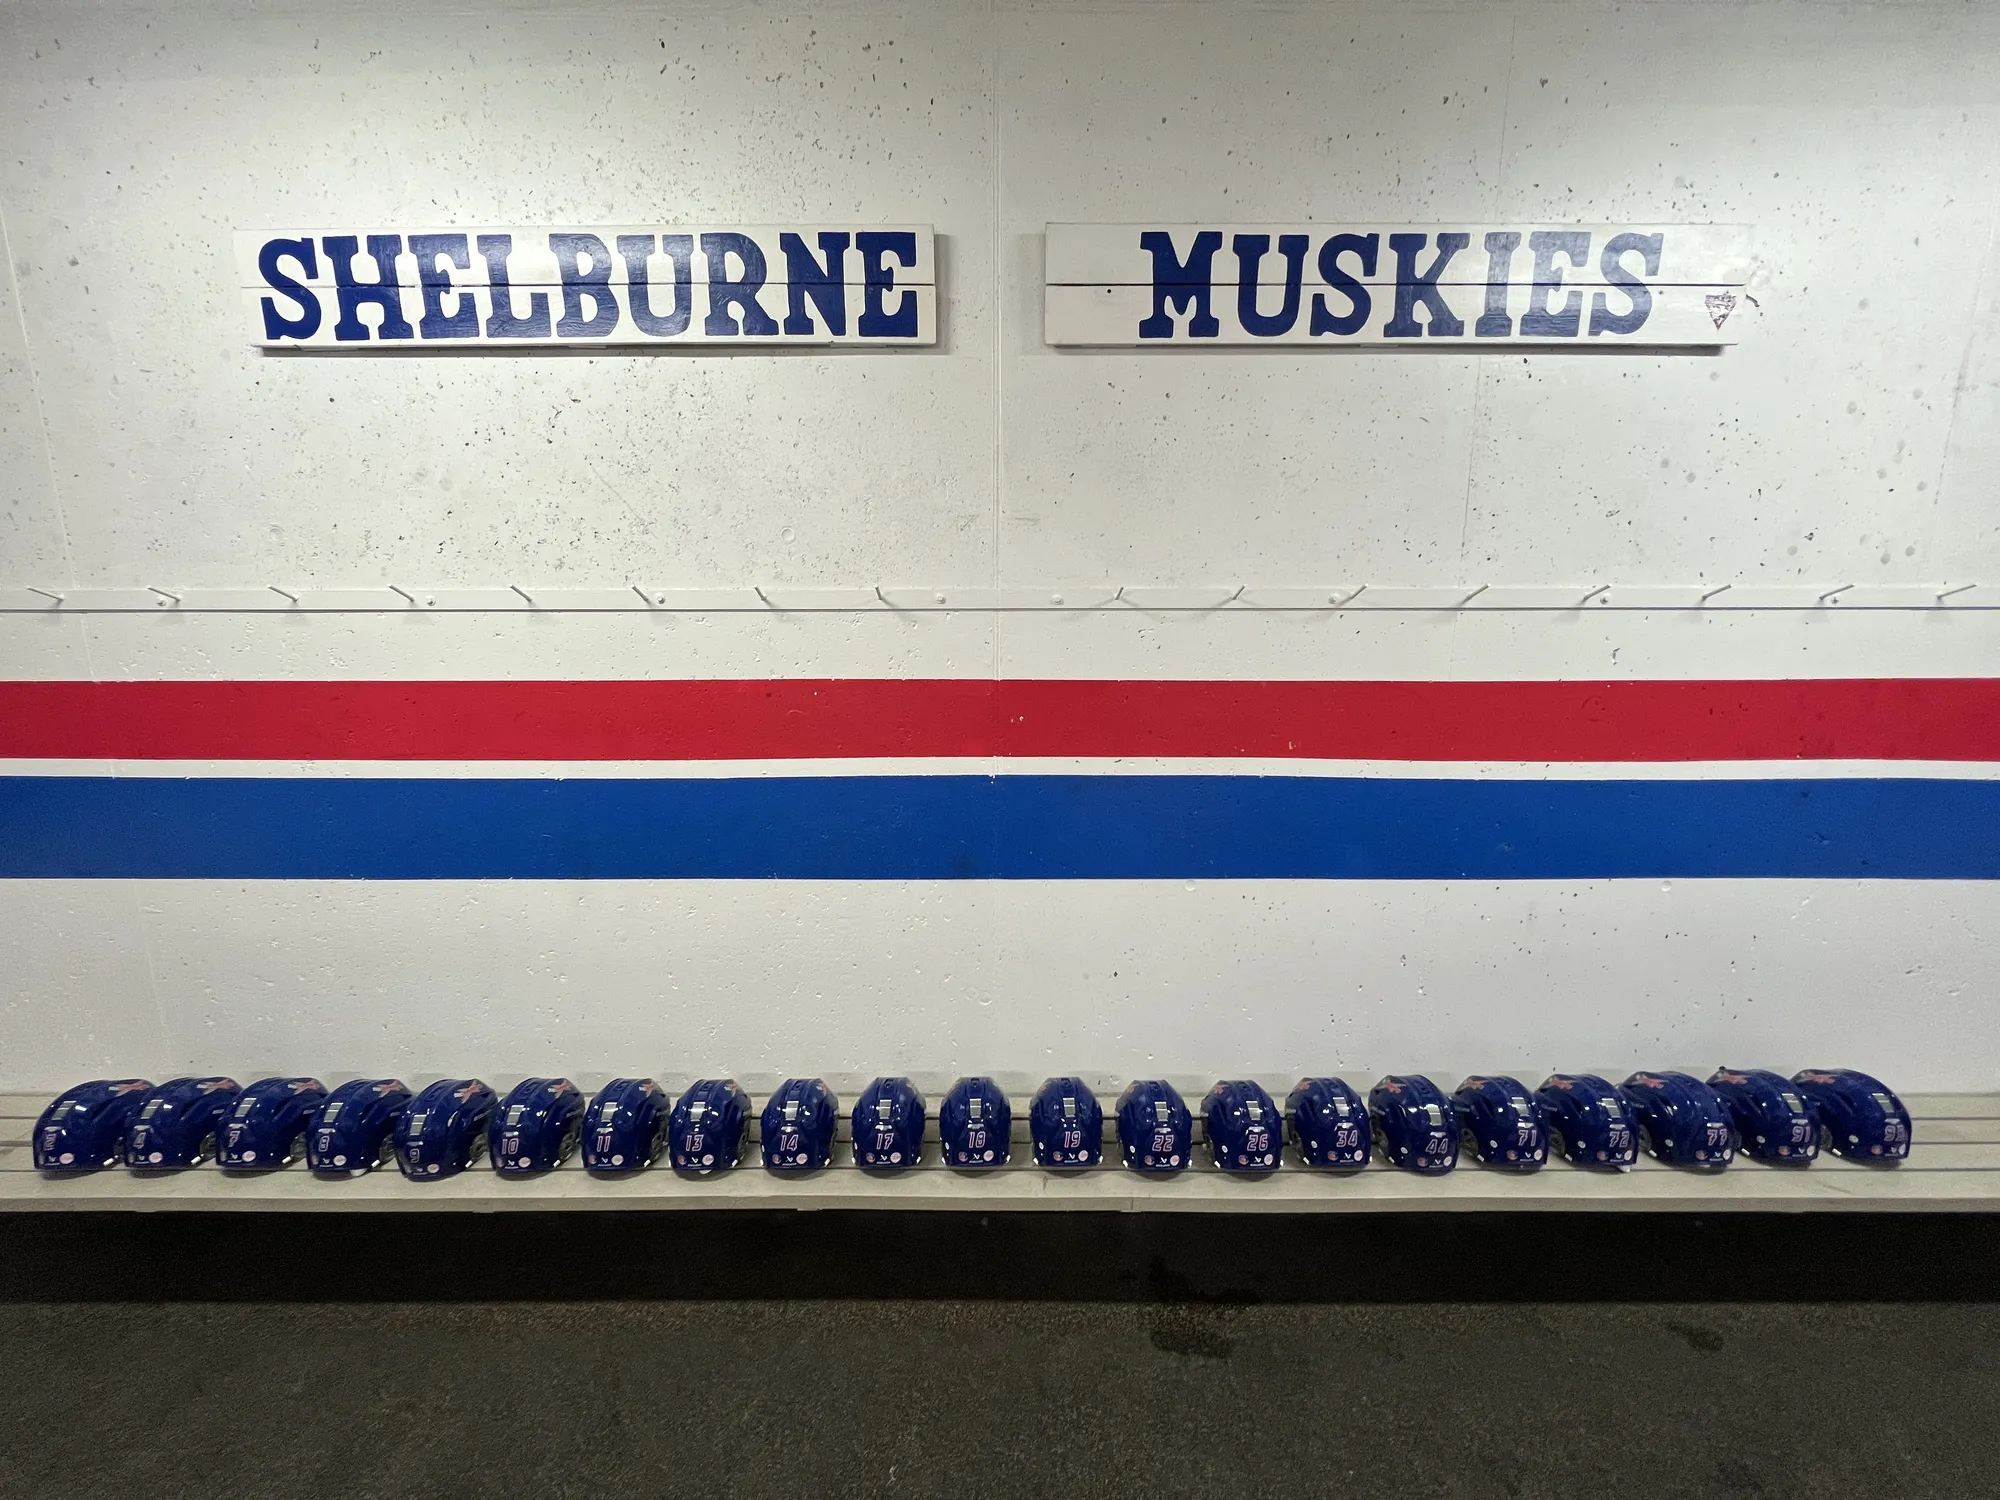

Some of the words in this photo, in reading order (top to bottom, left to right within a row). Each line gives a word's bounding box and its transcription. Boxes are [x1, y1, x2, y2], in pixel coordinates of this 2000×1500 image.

[258, 231, 918, 340] SHELBURNE
[1139, 231, 1665, 338] MUSKIES
[133, 1132, 147, 1149] 4
[685, 1134, 704, 1151] 13
[780, 1134, 799, 1151] 14
[876, 1132, 895, 1150] 17
[968, 1130, 986, 1148] 18
[1063, 1130, 1081, 1148] 19
[1151, 1134, 1174, 1151] 22
[1246, 1133, 1269, 1151] 26
[1336, 1129, 1358, 1148] 34
[1518, 1129, 1537, 1146] 71
[1609, 1130, 1630, 1148] 72
[1707, 1128, 1728, 1146] 77
[1791, 1125, 1811, 1143] 91
[501, 1137, 519, 1155] 10
[596, 1135, 611, 1152] 11
[1425, 1138, 1448, 1154] 44
[409, 1148, 420, 1163] 9
